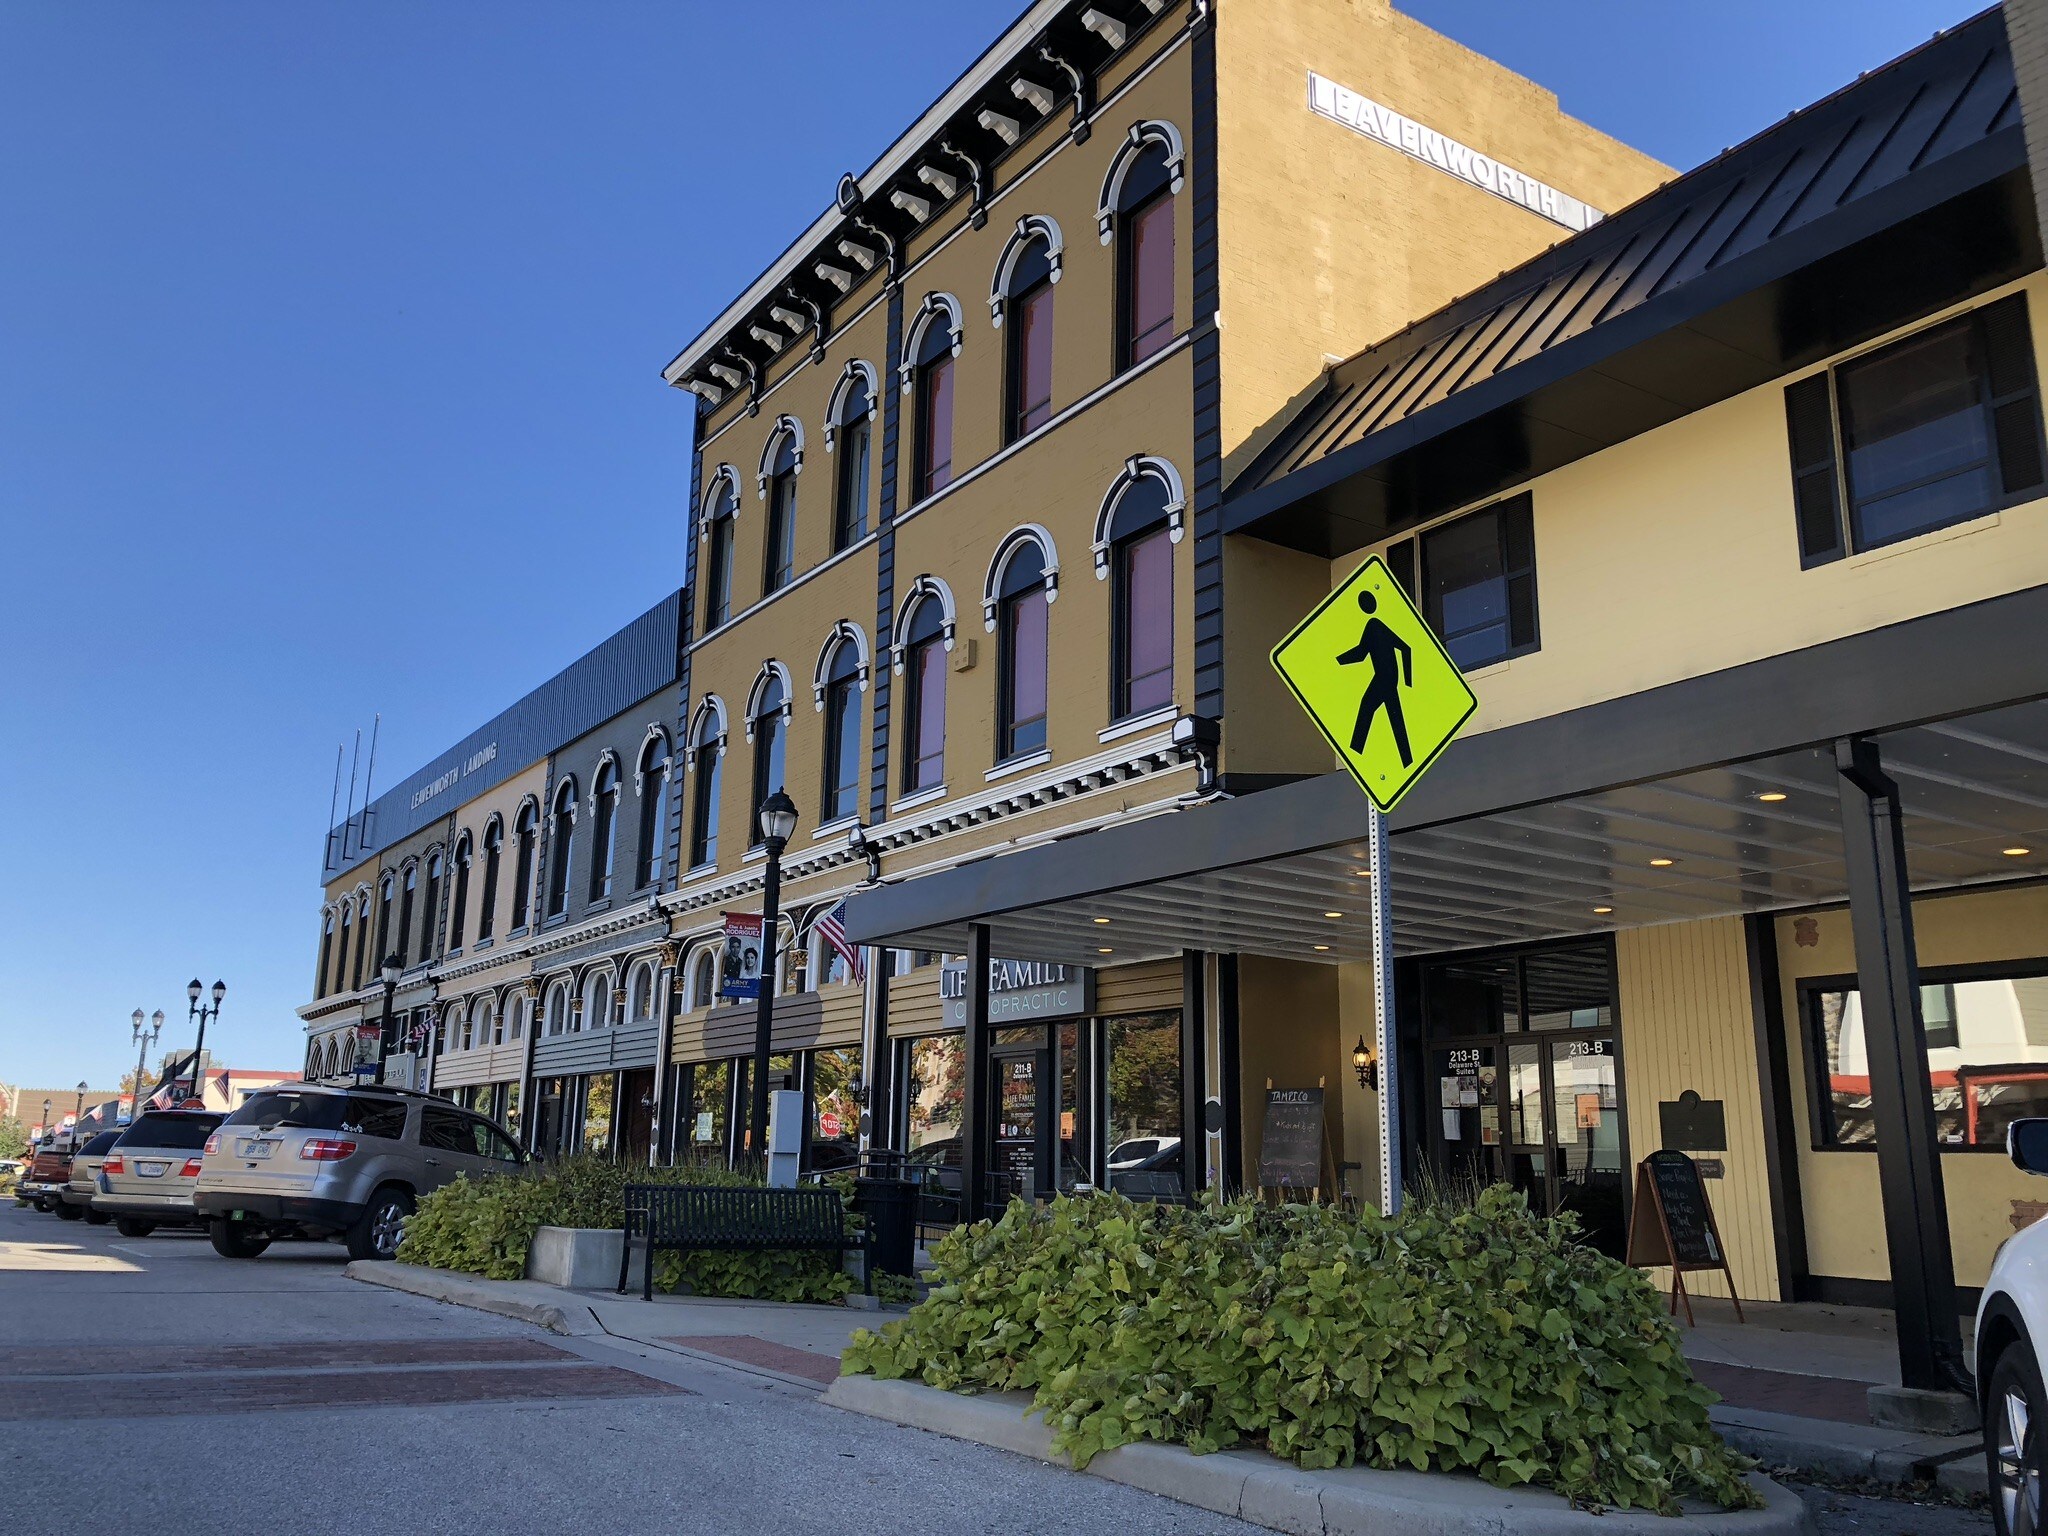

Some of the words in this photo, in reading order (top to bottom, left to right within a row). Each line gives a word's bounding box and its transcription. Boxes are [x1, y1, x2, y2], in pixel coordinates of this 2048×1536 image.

[1312, 75, 1558, 218] LEAVENWORTH
[410, 766, 460, 811] LEAVENWORTH
[463, 742, 498, 778] LANDING
[939, 969, 967, 998] LIF
[954, 990, 1068, 1019] COPRACTIC
[1450, 1049, 1480, 1062] 213-B
[1570, 1041, 1604, 1055] 213-B
[1014, 1063, 1032, 1074] 211-B
[1271, 1090, 1309, 1102] TAMPICO
